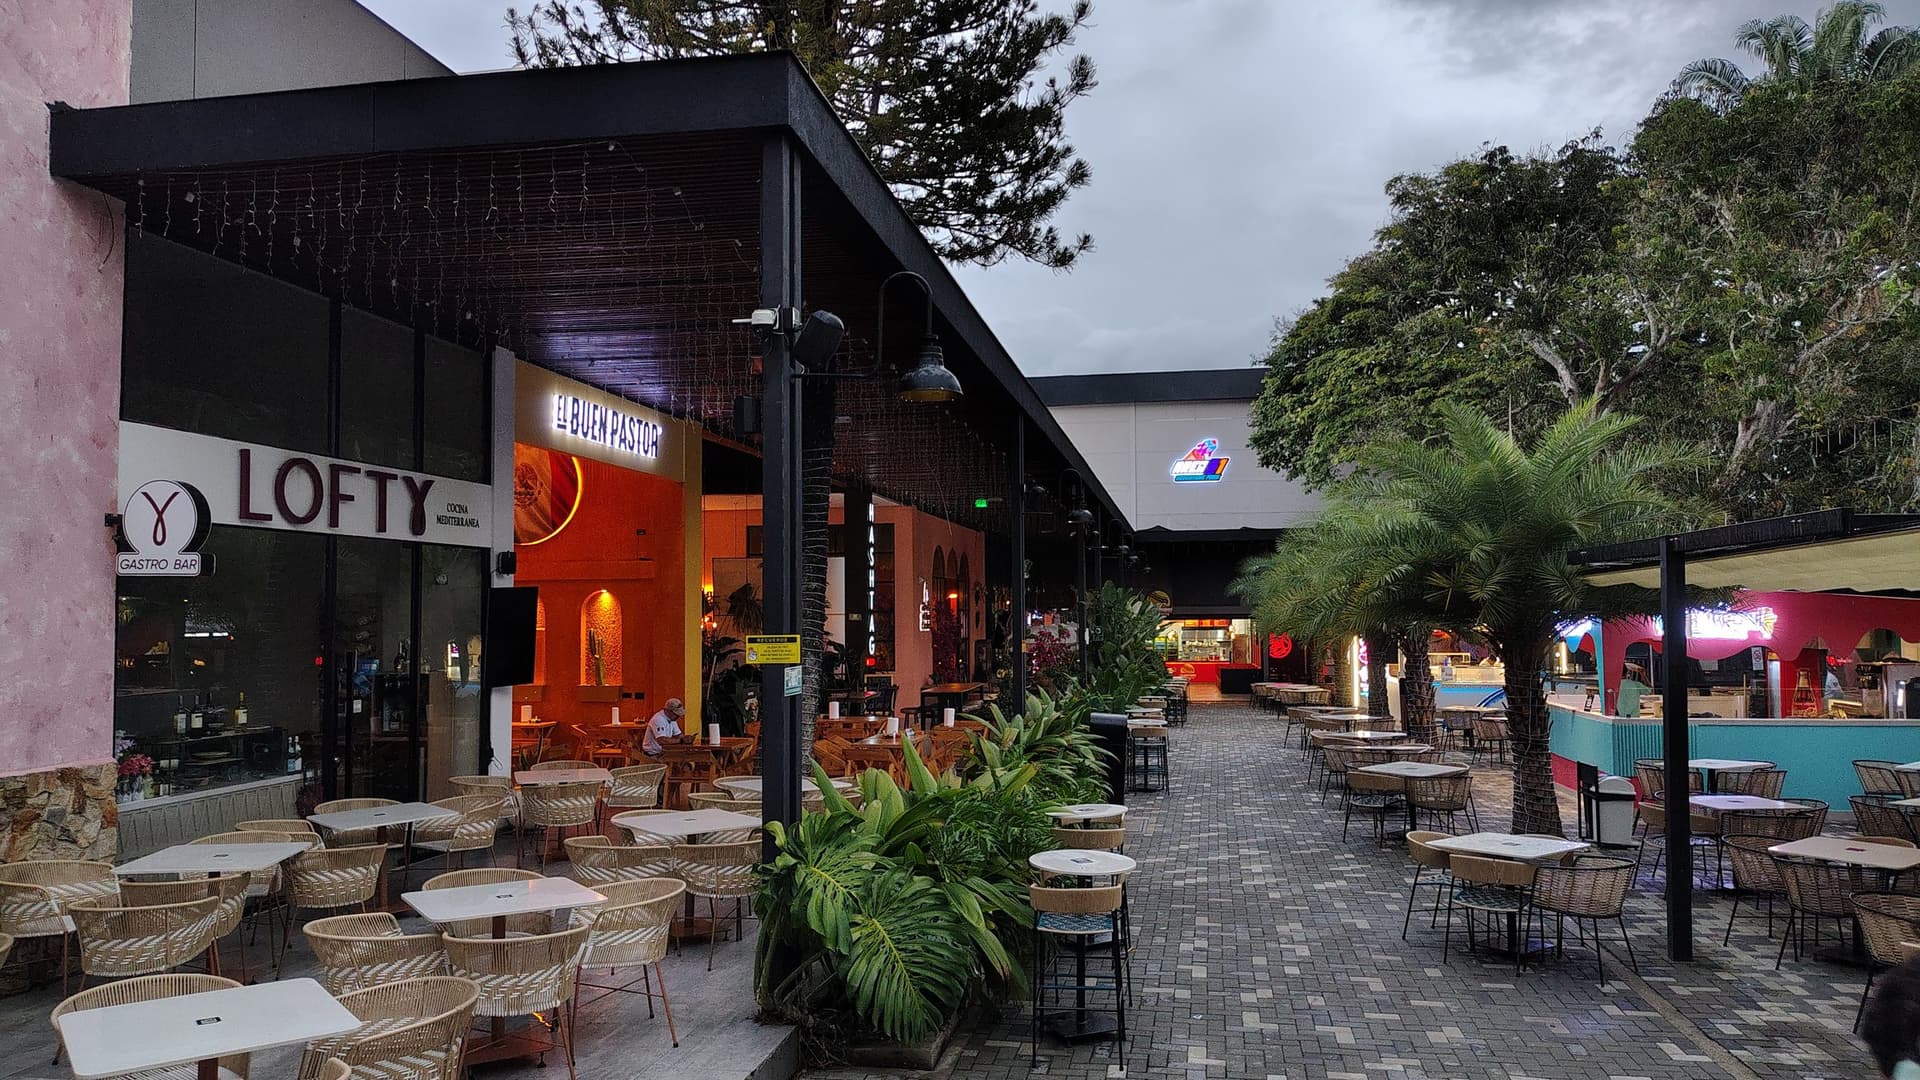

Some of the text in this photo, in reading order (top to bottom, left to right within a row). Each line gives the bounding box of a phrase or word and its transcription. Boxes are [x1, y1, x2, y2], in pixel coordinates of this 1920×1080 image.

[557, 395, 659, 457] EL BUEN PASTOR
[239, 448, 435, 536] LOFTY
[446, 502, 469, 514] COCINA
[436, 514, 480, 529] MEDITERRANEA
[119, 558, 198, 570] GASTRO BAR
